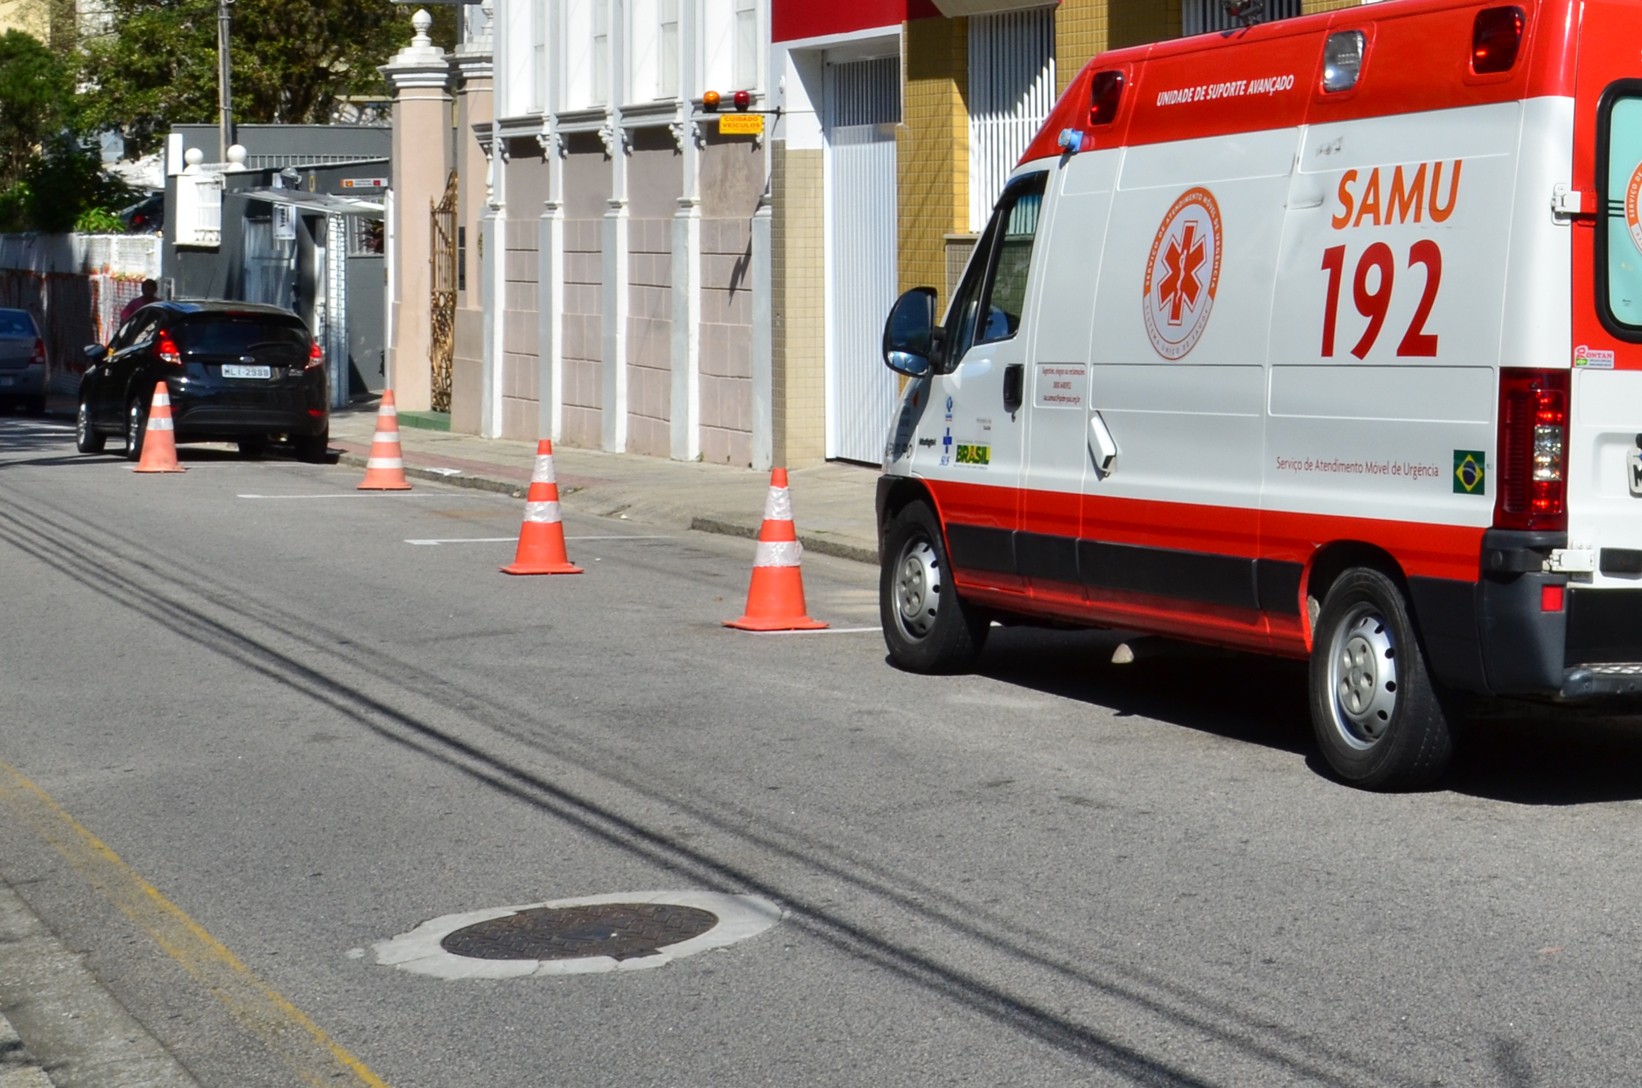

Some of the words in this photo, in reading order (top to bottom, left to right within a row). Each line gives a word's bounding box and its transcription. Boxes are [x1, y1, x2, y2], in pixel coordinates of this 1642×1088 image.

[1156, 88, 1194, 106] UNIDADE
[1194, 86, 1207, 102] DE
[1206, 80, 1247, 100] SUPORTE
[1246, 74, 1294, 96] AVANÇADO
[1331, 160, 1463, 230] SAMU
[1158, 226, 1166, 238] DE
[1214, 218, 1220, 230] DE
[1320, 239, 1442, 360] 192
[1577, 348, 1612, 359] RONTAN
[956, 444, 991, 465] BRASIL
[1276, 456, 1302, 473] Serviço
[1304, 457, 1314, 471] de
[1314, 458, 1363, 474] Atendimento
[1365, 460, 1390, 475] Móvel
[1391, 461, 1402, 475] de
[1404, 462, 1439, 480] Urgência
